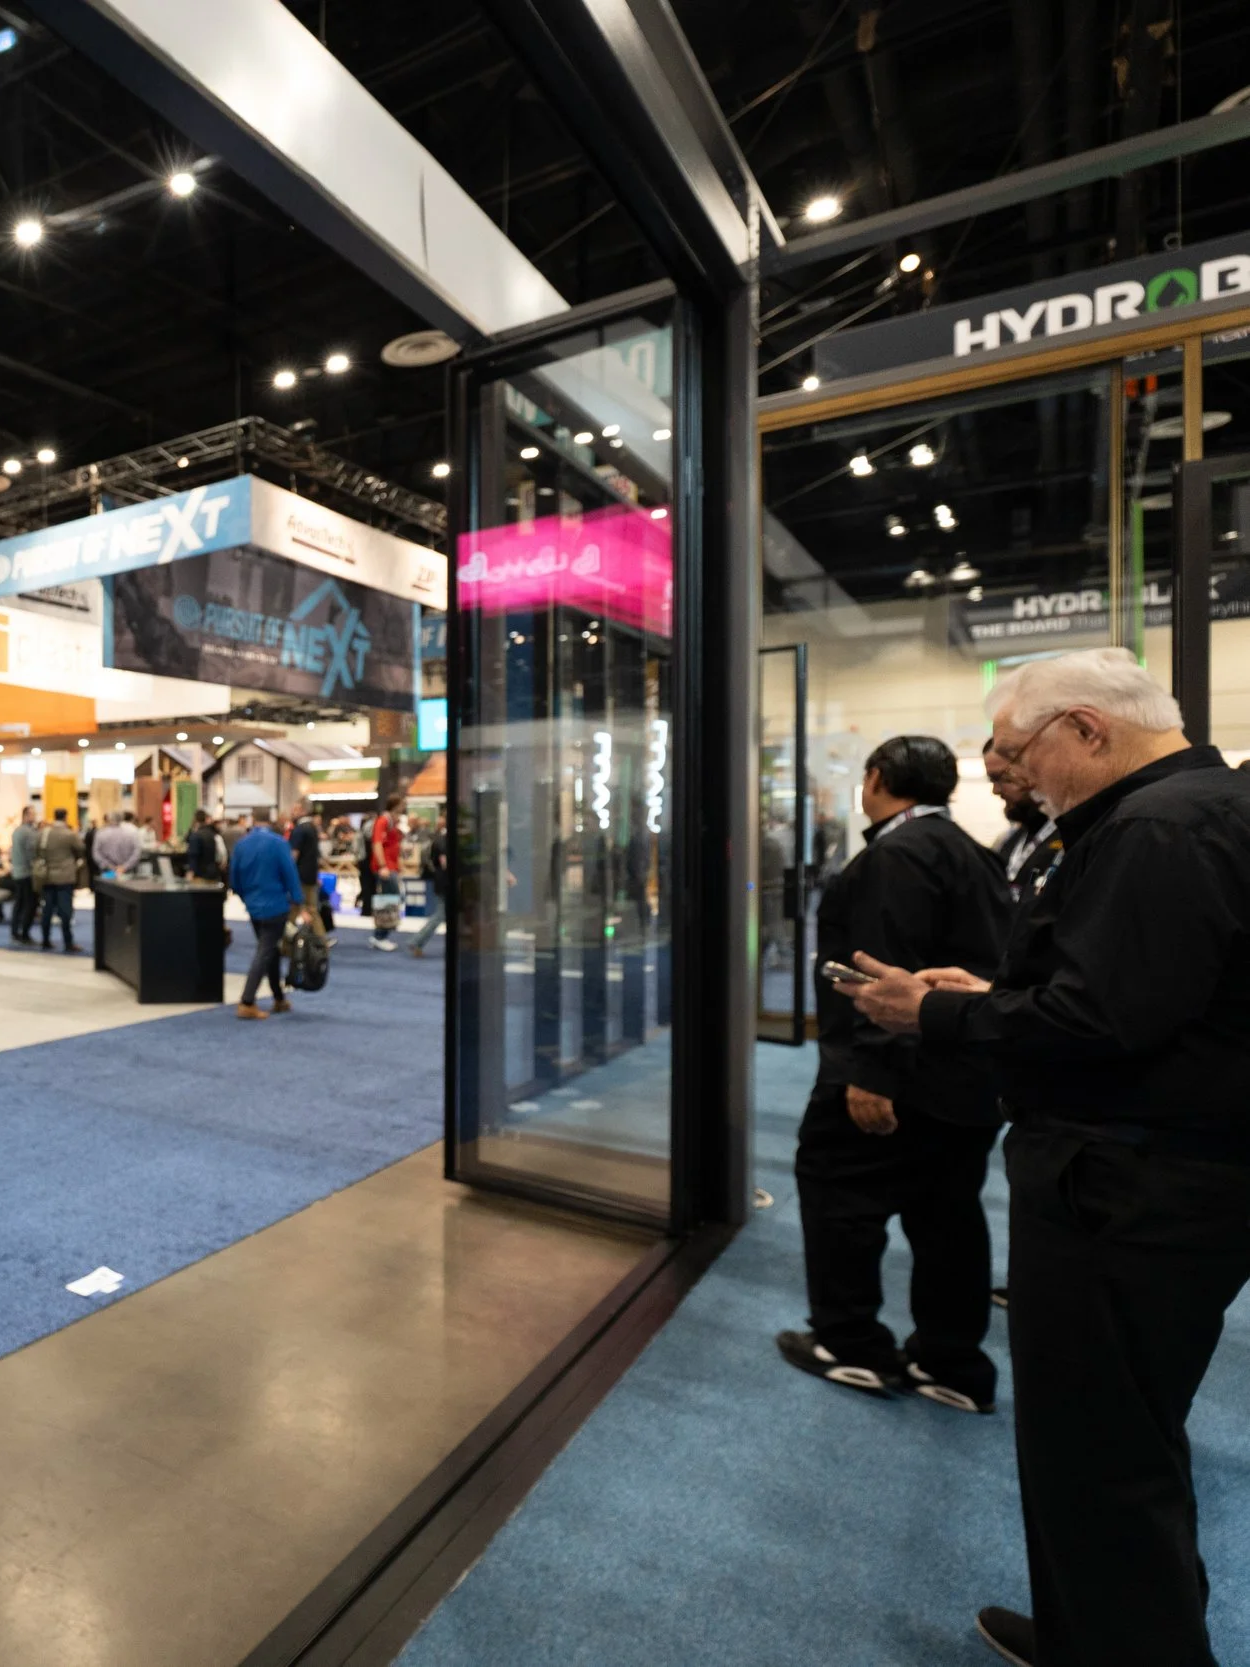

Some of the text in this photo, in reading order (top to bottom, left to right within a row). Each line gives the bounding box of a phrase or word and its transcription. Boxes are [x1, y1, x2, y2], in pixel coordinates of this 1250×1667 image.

[108, 485, 231, 565] NEXT
[280, 607, 371, 697] NEXT
[970, 622, 1005, 641] THE
[1006, 615, 1071, 639] BOARD
